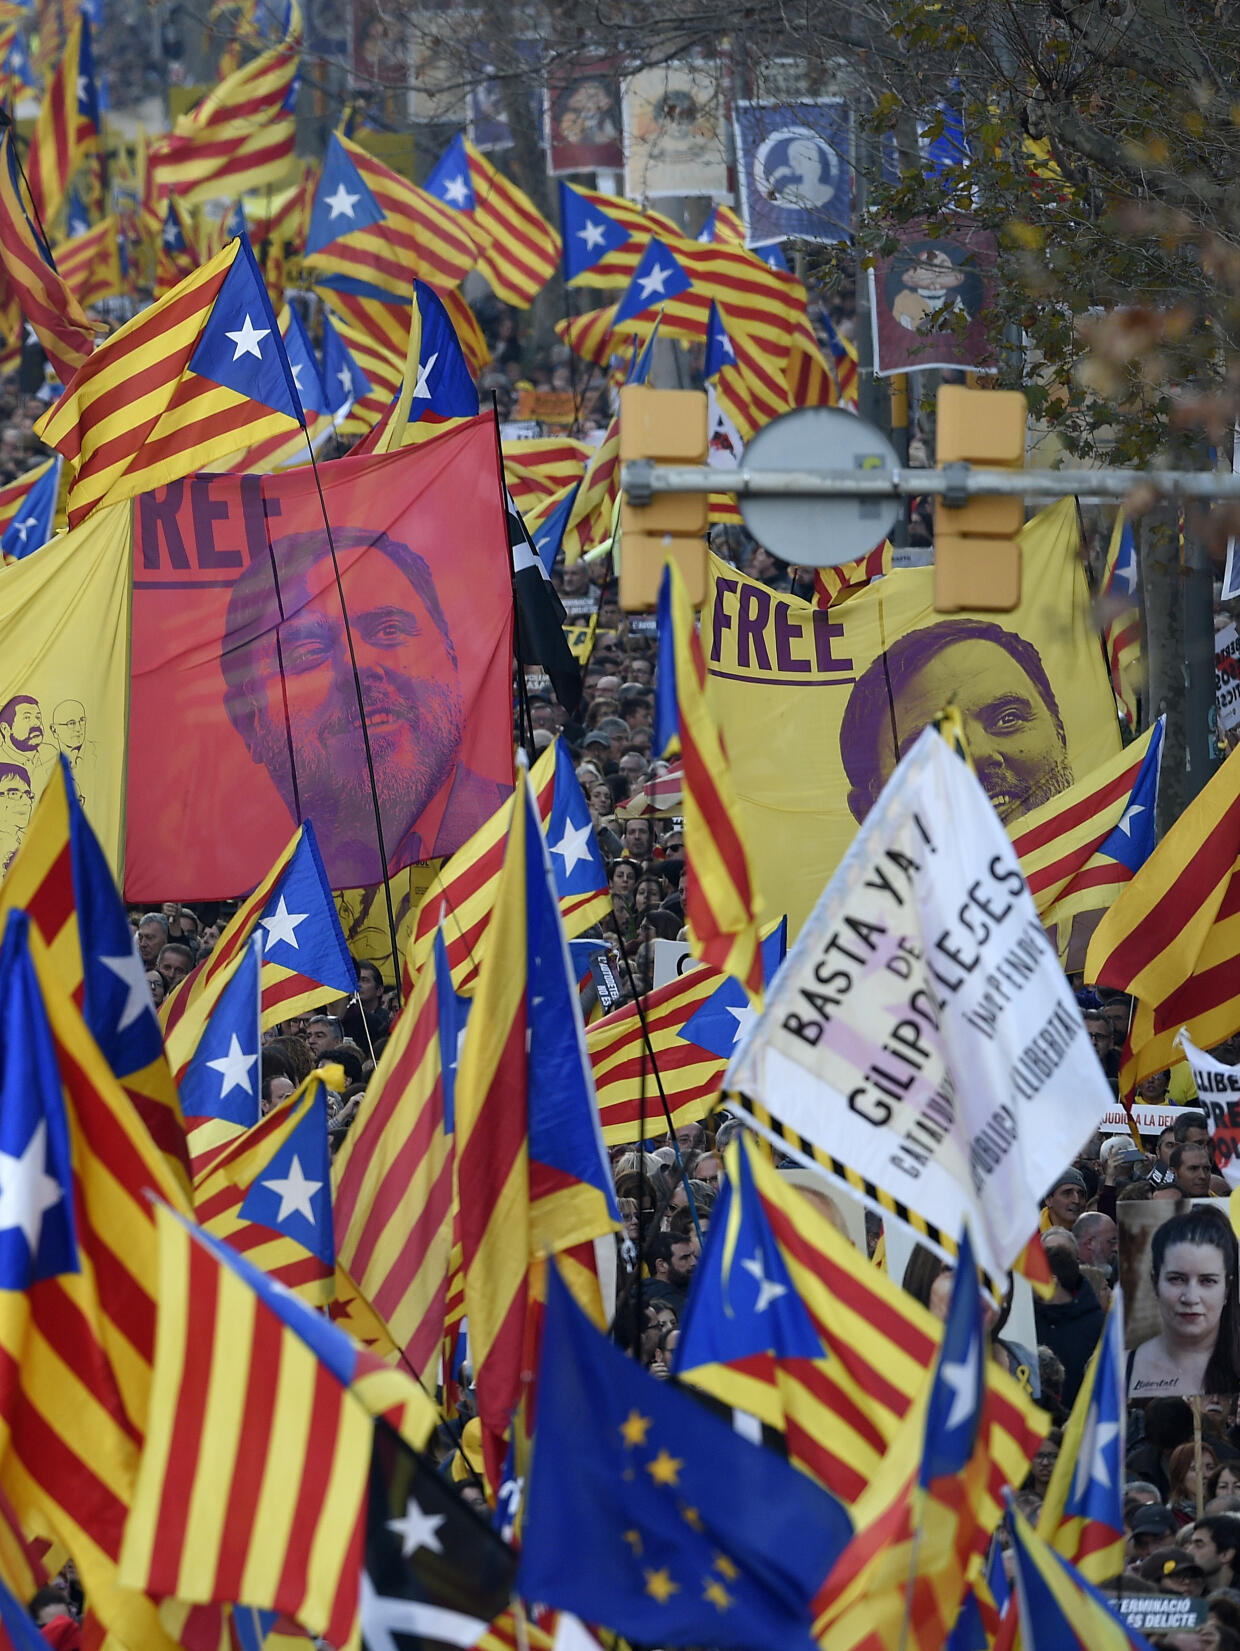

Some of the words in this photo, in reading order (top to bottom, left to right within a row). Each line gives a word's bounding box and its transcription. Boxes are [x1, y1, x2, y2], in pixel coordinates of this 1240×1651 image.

[711, 577, 854, 673] FREE
[782, 916, 887, 1047] BASTA
[865, 849, 921, 905] YA
[886, 940, 923, 980] DE
[1144, 1116, 1155, 1126] LA
